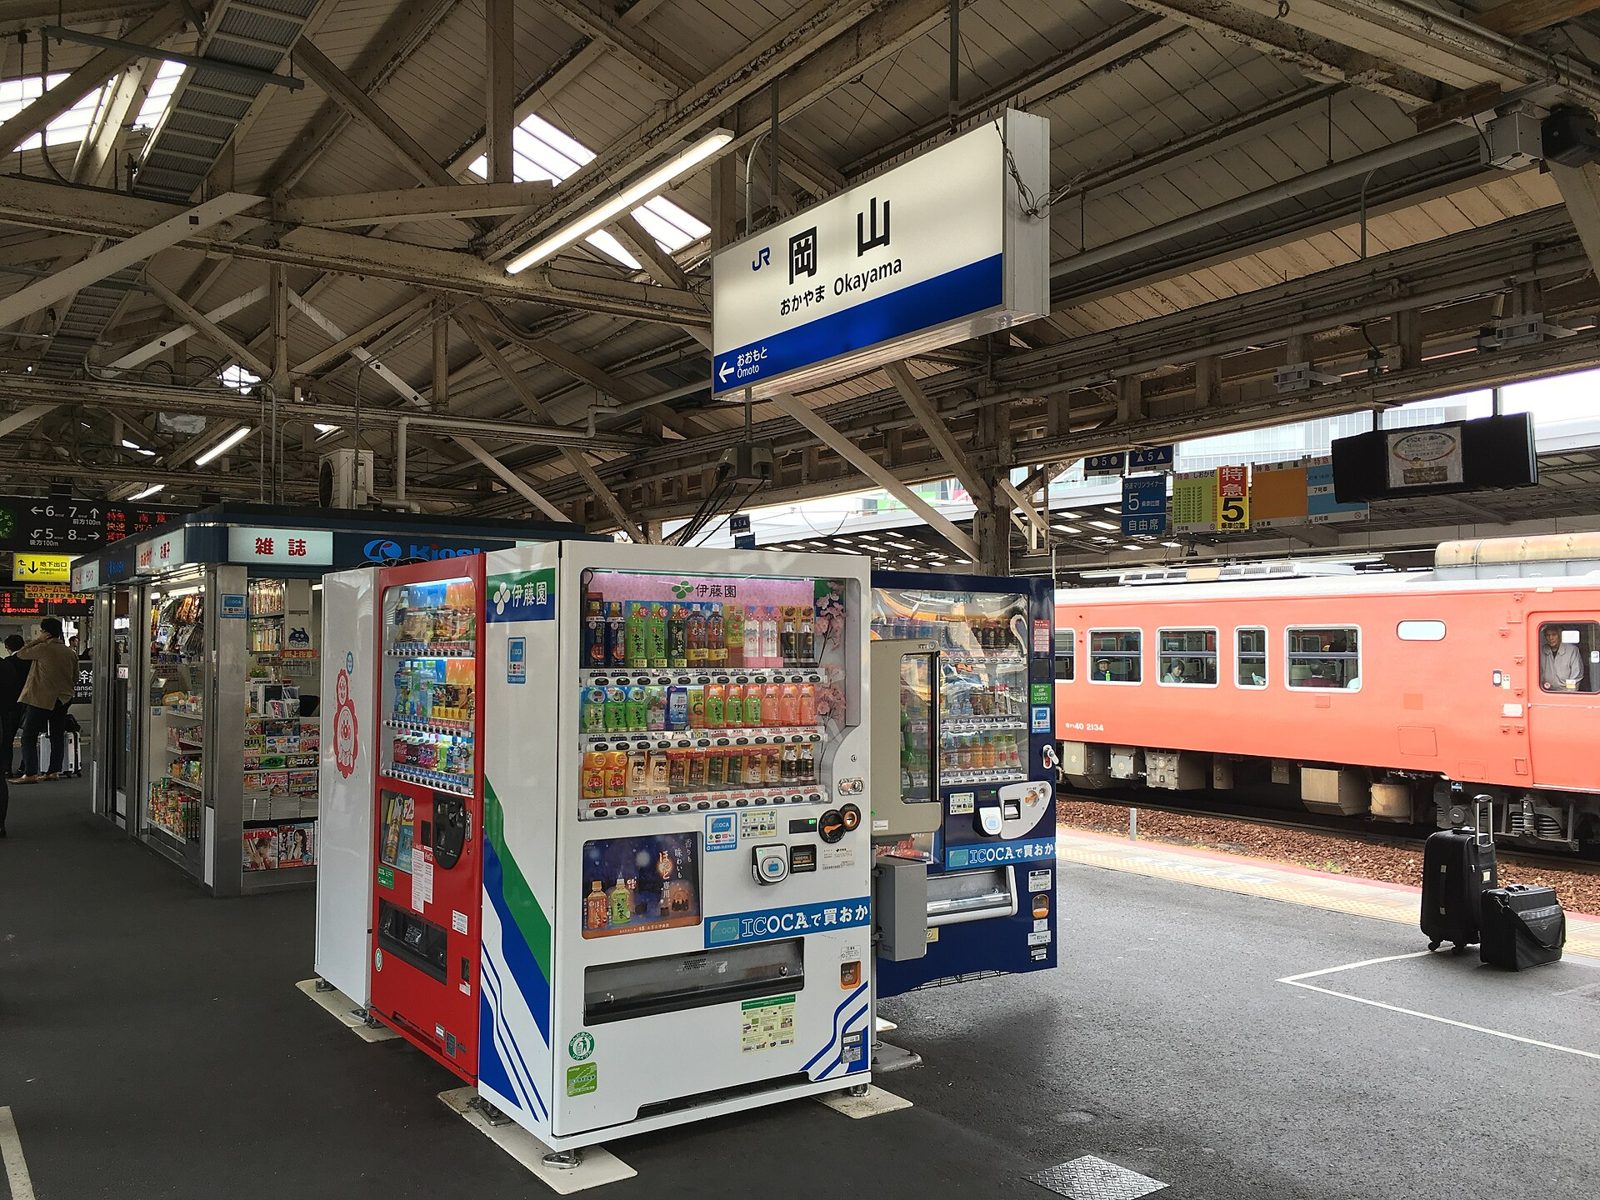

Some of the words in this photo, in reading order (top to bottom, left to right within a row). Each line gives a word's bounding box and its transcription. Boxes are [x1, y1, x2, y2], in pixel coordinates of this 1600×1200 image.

[789, 196, 891, 285] 岡山
[751, 246, 771, 272] JR
[833, 257, 903, 297] Okayama
[780, 284, 826, 317] おかやま
[737, 346, 768, 367] おおもと
[1101, 456, 1108, 466] 5
[1147, 451, 1154, 462] 5
[1222, 467, 1244, 496] 特急
[1128, 492, 1140, 511] 5
[1221, 496, 1245, 523] 5
[45, 505, 55, 517] 6
[68, 506, 78, 518] 7
[1128, 518, 1159, 531] 自由席
[45, 528, 54, 540] 5
[67, 529, 77, 541] 8
[255, 537, 307, 557] 雑誌
[39, 560, 68, 568] 地下出口
[511, 581, 548, 607] 伊藤園
[695, 583, 738, 598] 伊藤園
[1086, 723, 1104, 731] 2134
